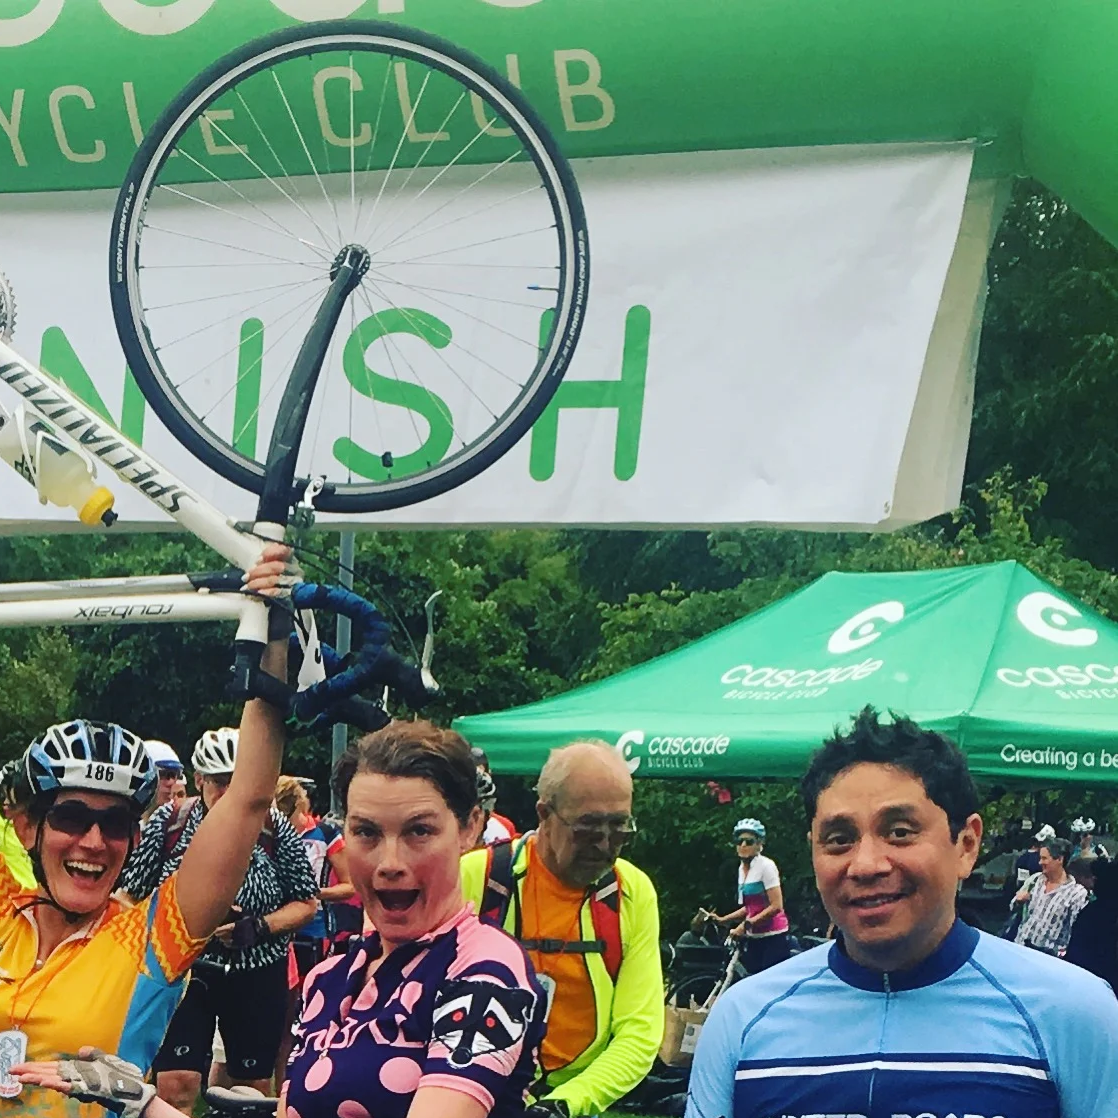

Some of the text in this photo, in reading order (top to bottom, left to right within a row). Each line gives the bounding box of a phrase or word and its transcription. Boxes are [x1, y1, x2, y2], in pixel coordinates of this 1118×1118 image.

[312, 48, 616, 148] CLUB
[73, 603, 175, 620] roubaix
[720, 657, 884, 688] cascade
[722, 686, 829, 701] BICYCLE CLUB
[647, 733, 731, 755] cascade
[647, 756, 704, 768] BICYCLE CLUB
[1000, 743, 1078, 771] Creating
[1082, 751, 1095, 767] a
[84, 763, 115, 782] 186
